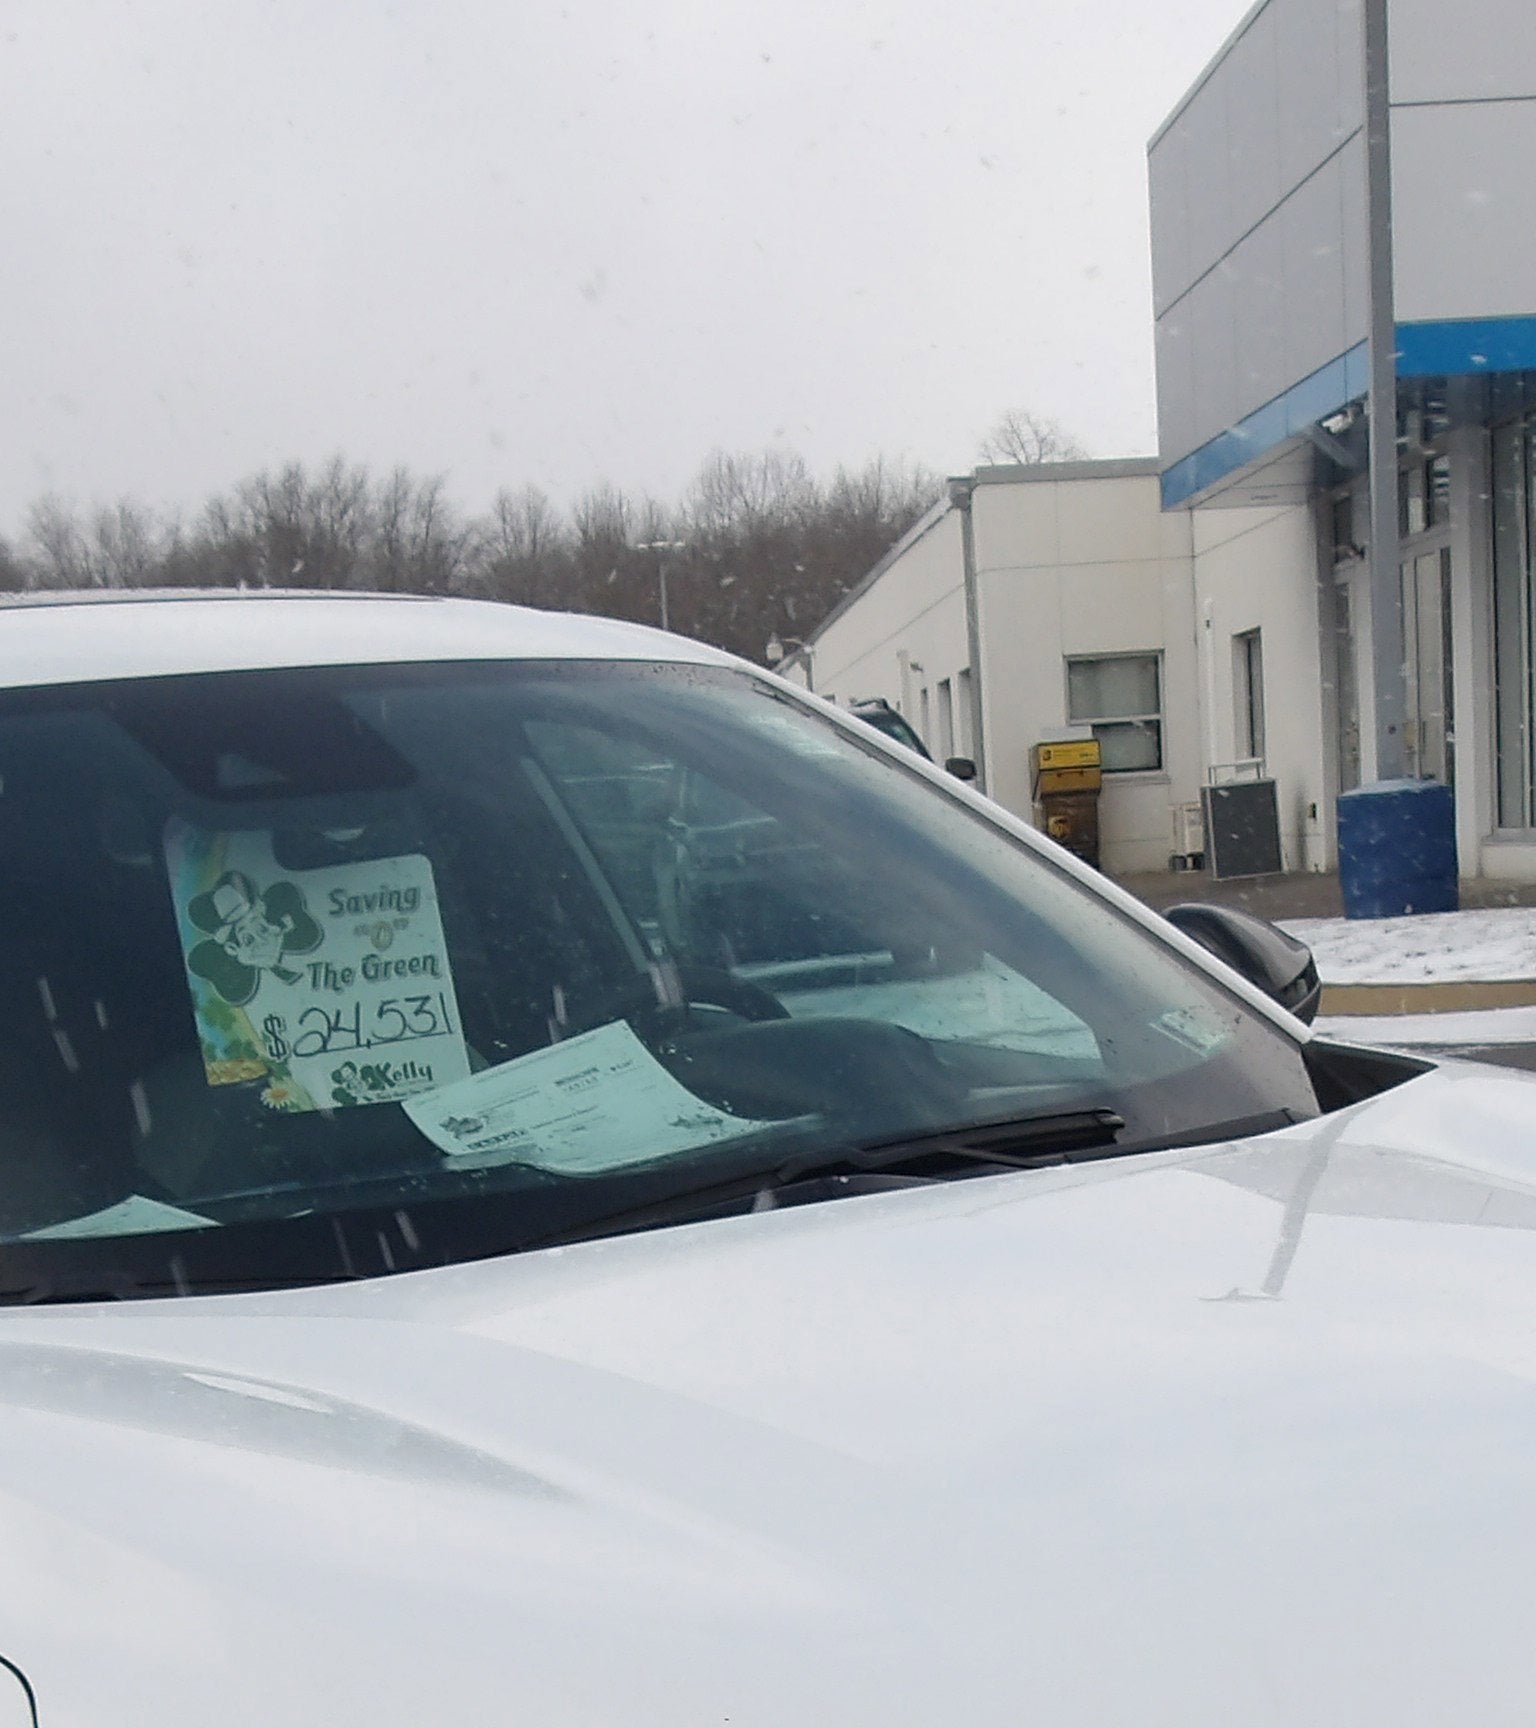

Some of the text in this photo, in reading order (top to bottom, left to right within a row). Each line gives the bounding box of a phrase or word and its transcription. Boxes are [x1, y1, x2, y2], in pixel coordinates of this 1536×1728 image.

[327, 886, 421, 917] Saving
[307, 953, 441, 992] The Green
[375, 1060, 433, 1088] Kelly
